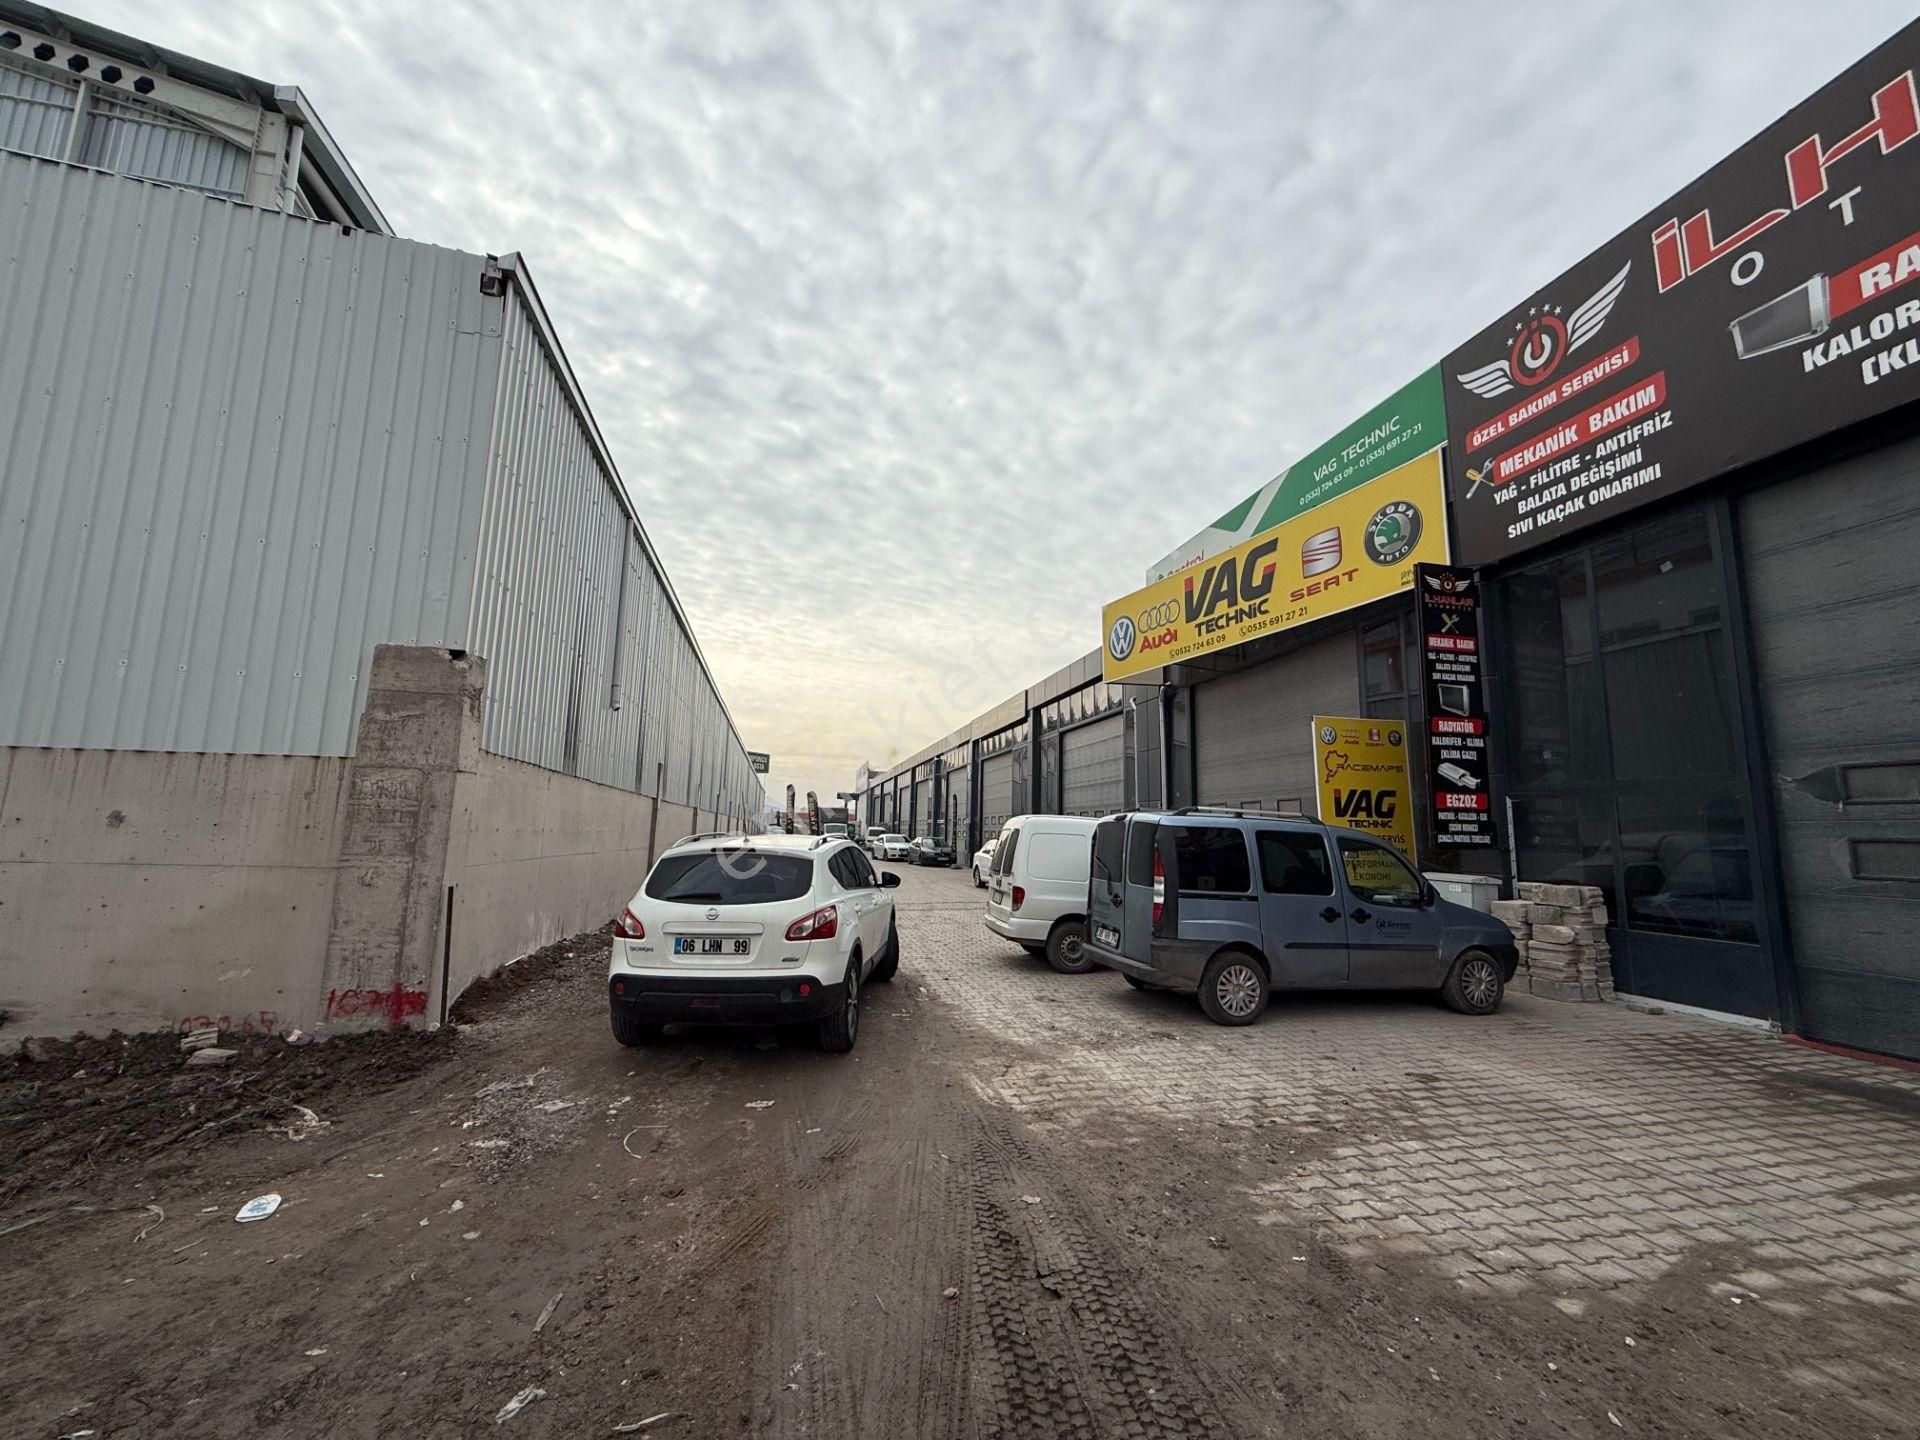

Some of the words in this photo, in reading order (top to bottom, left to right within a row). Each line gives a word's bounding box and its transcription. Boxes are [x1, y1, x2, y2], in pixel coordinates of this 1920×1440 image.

[1803, 298, 1920, 373] KALOR
[1473, 424, 1505, 447] ÖZEL
[1508, 390, 1557, 427] BAKIM
[1561, 346, 1630, 398] SERVİSİ
[1313, 458, 1338, 481] VAG
[1340, 416, 1400, 463] TECHNIC
[1343, 466, 1354, 478] 09
[1386, 437, 1400, 450] 691
[1401, 429, 1411, 442] 27
[1412, 422, 1423, 435] 21
[1493, 482, 1518, 506] YAĞ
[1529, 453, 1581, 490] FİLİTRE
[1595, 410, 1673, 459] ANTİFRİZ
[1500, 423, 1579, 477] MEKANİK
[1588, 384, 1656, 434] BAKIM
[1507, 517, 1534, 540] SIVI
[1536, 494, 1586, 523] KAÇAK
[1588, 462, 1662, 506] ONARIMI
[1517, 481, 1567, 515] BALATA
[1570, 444, 1643, 493] DEĞİŞİMİ
[1184, 537, 1279, 624] VAG
[1378, 545, 1409, 562] AUTO
[1290, 568, 1359, 603] SEAT
[1247, 620, 1267, 634] 0535
[1269, 614, 1283, 626] 691
[1285, 610, 1296, 621] 27
[1298, 606, 1308, 617] 21
[1438, 719, 1474, 733] RADYATÖR
[1334, 788, 1396, 819] VAG
[1446, 794, 1477, 808] EGZOZ
[682, 938, 695, 952] 06
[702, 939, 722, 953] LHN
[734, 940, 748, 953] 99
